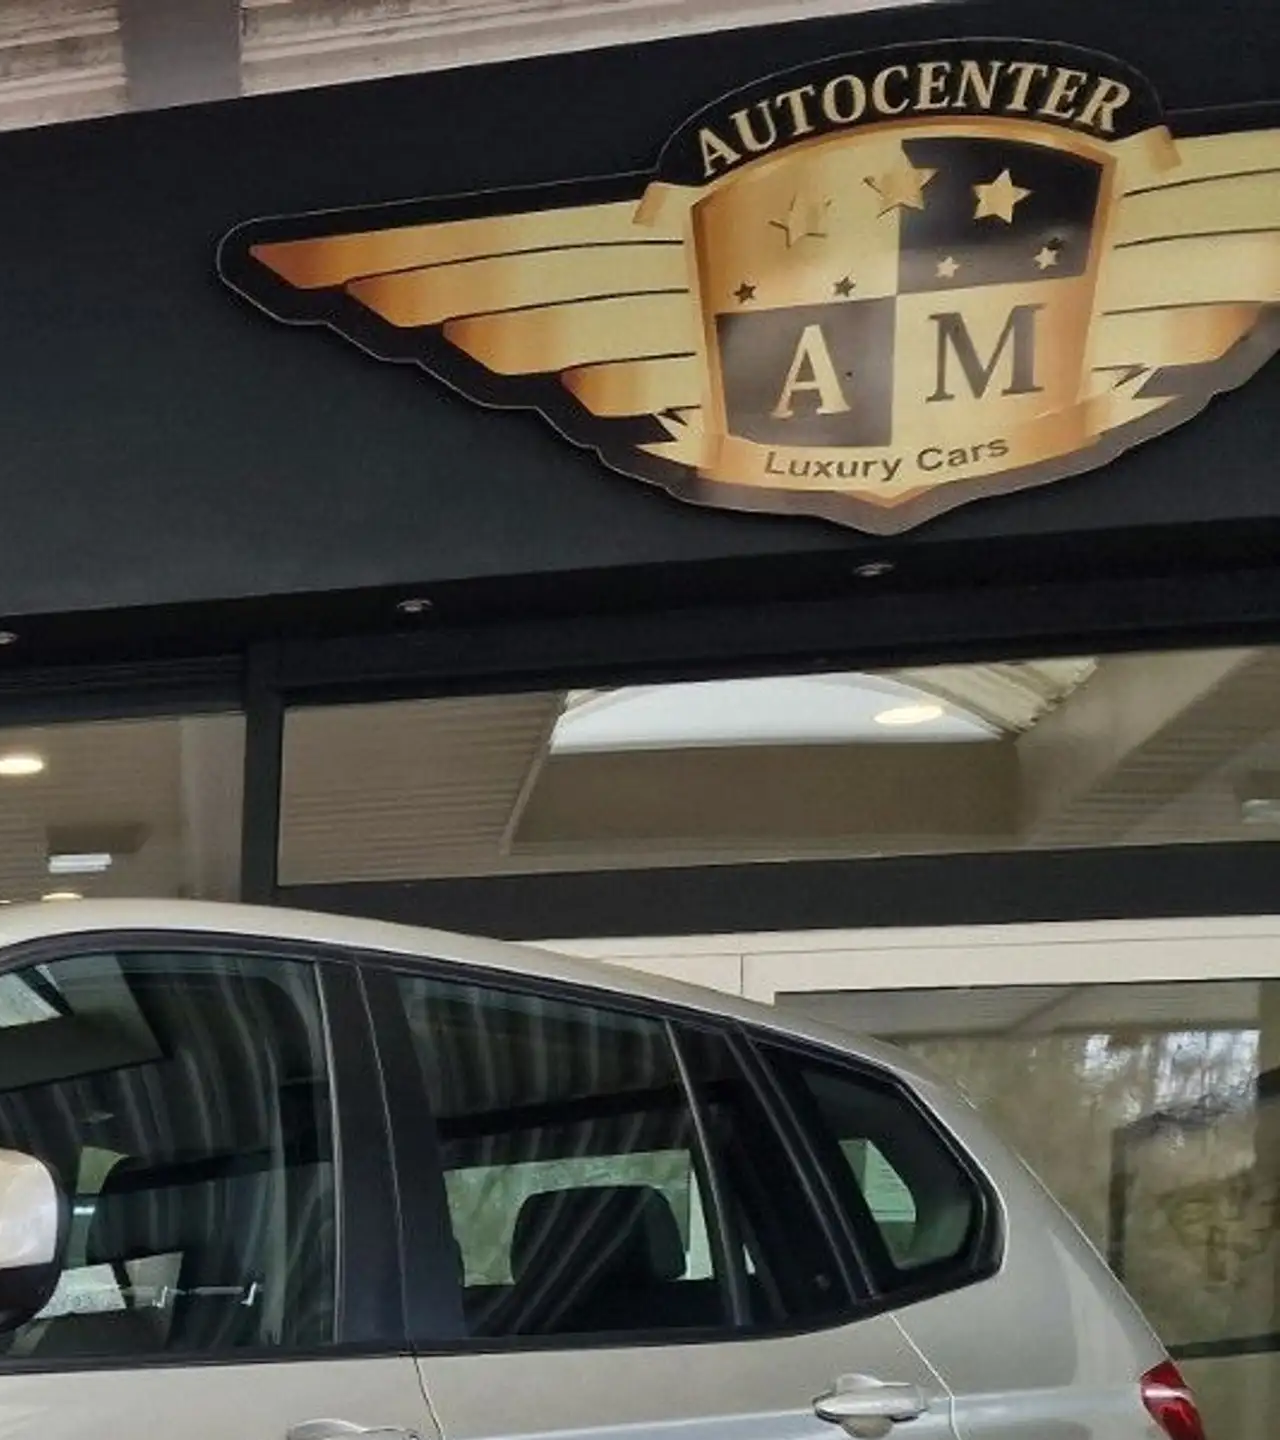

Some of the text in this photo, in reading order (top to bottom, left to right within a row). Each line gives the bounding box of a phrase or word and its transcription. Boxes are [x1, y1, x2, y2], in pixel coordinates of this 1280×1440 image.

[698, 60, 1130, 178] AUTOCENTER
[769, 303, 1045, 420] A M
[764, 436, 1010, 483] Luxury Cars
